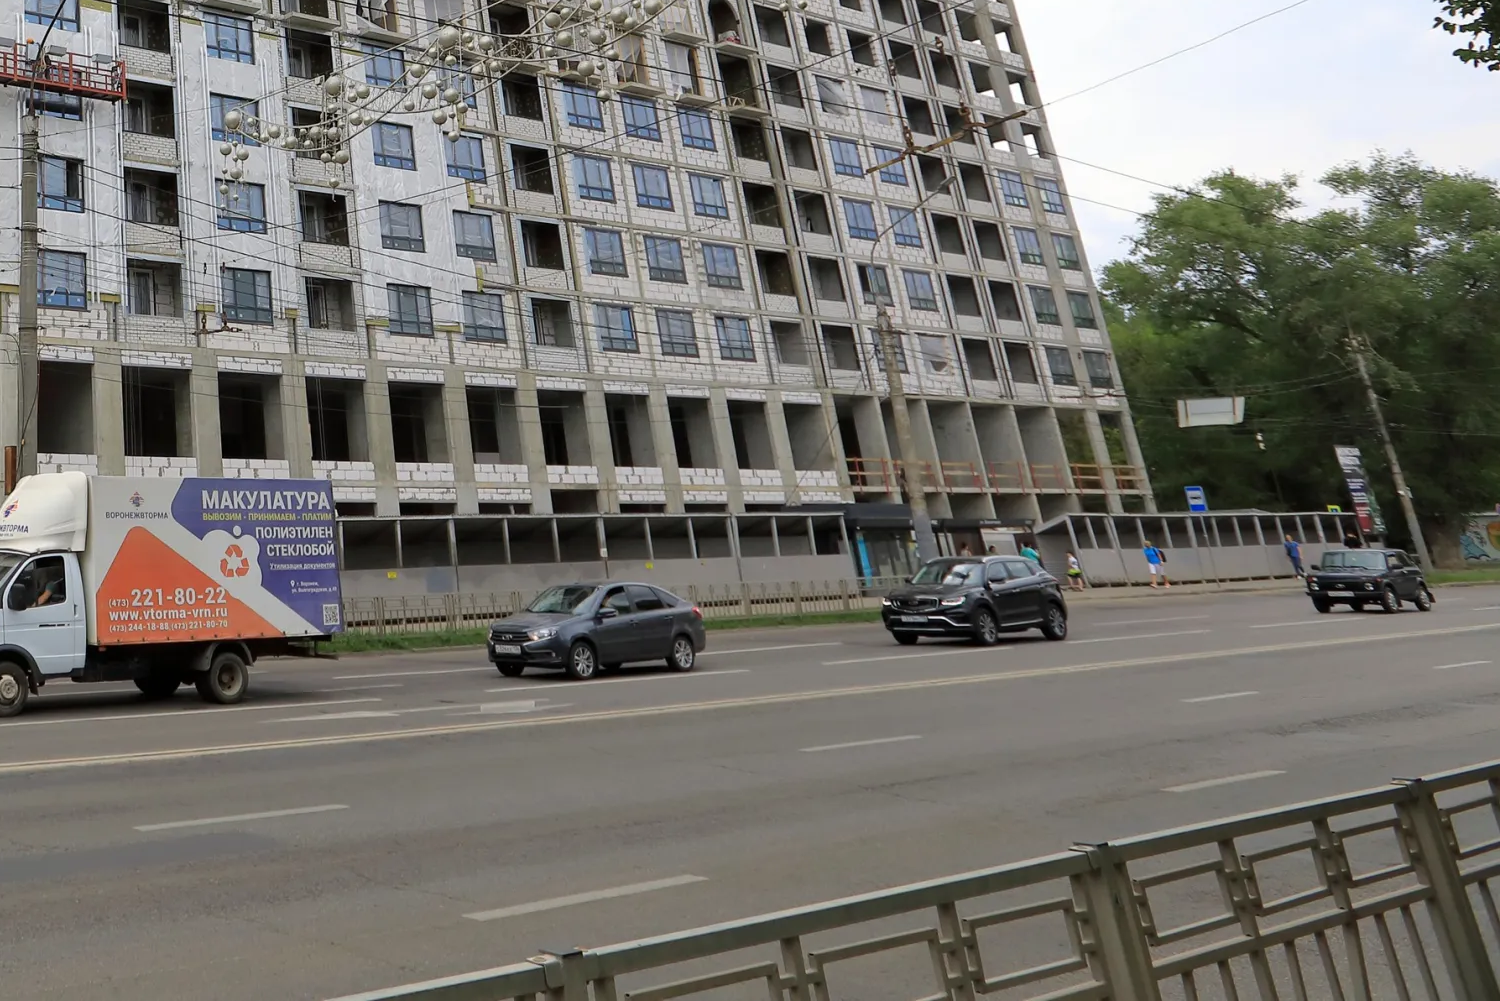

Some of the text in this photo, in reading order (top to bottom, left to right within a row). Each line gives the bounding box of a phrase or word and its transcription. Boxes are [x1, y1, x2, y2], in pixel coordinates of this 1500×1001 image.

[202, 490, 331, 510] МАКУЛАТУРА
[202, 513, 242, 521] ВЫВОЗИМ
[248, 513, 296, 521] ПРИНИМАЕМ
[256, 525, 333, 539] ПОЛИЭТИЛЕН
[266, 541, 335, 556] СТЕКЛОБОЙ
[270, 562, 336, 570] Утилизация документов
[108, 587, 227, 608] (473) 221-80-22
[109, 607, 228, 621] www.vtorma-vrn.ru
[109, 624, 127, 632] (473)
[171, 622, 188, 630] (473)
[189, 620, 228, 629] 221-80-70
